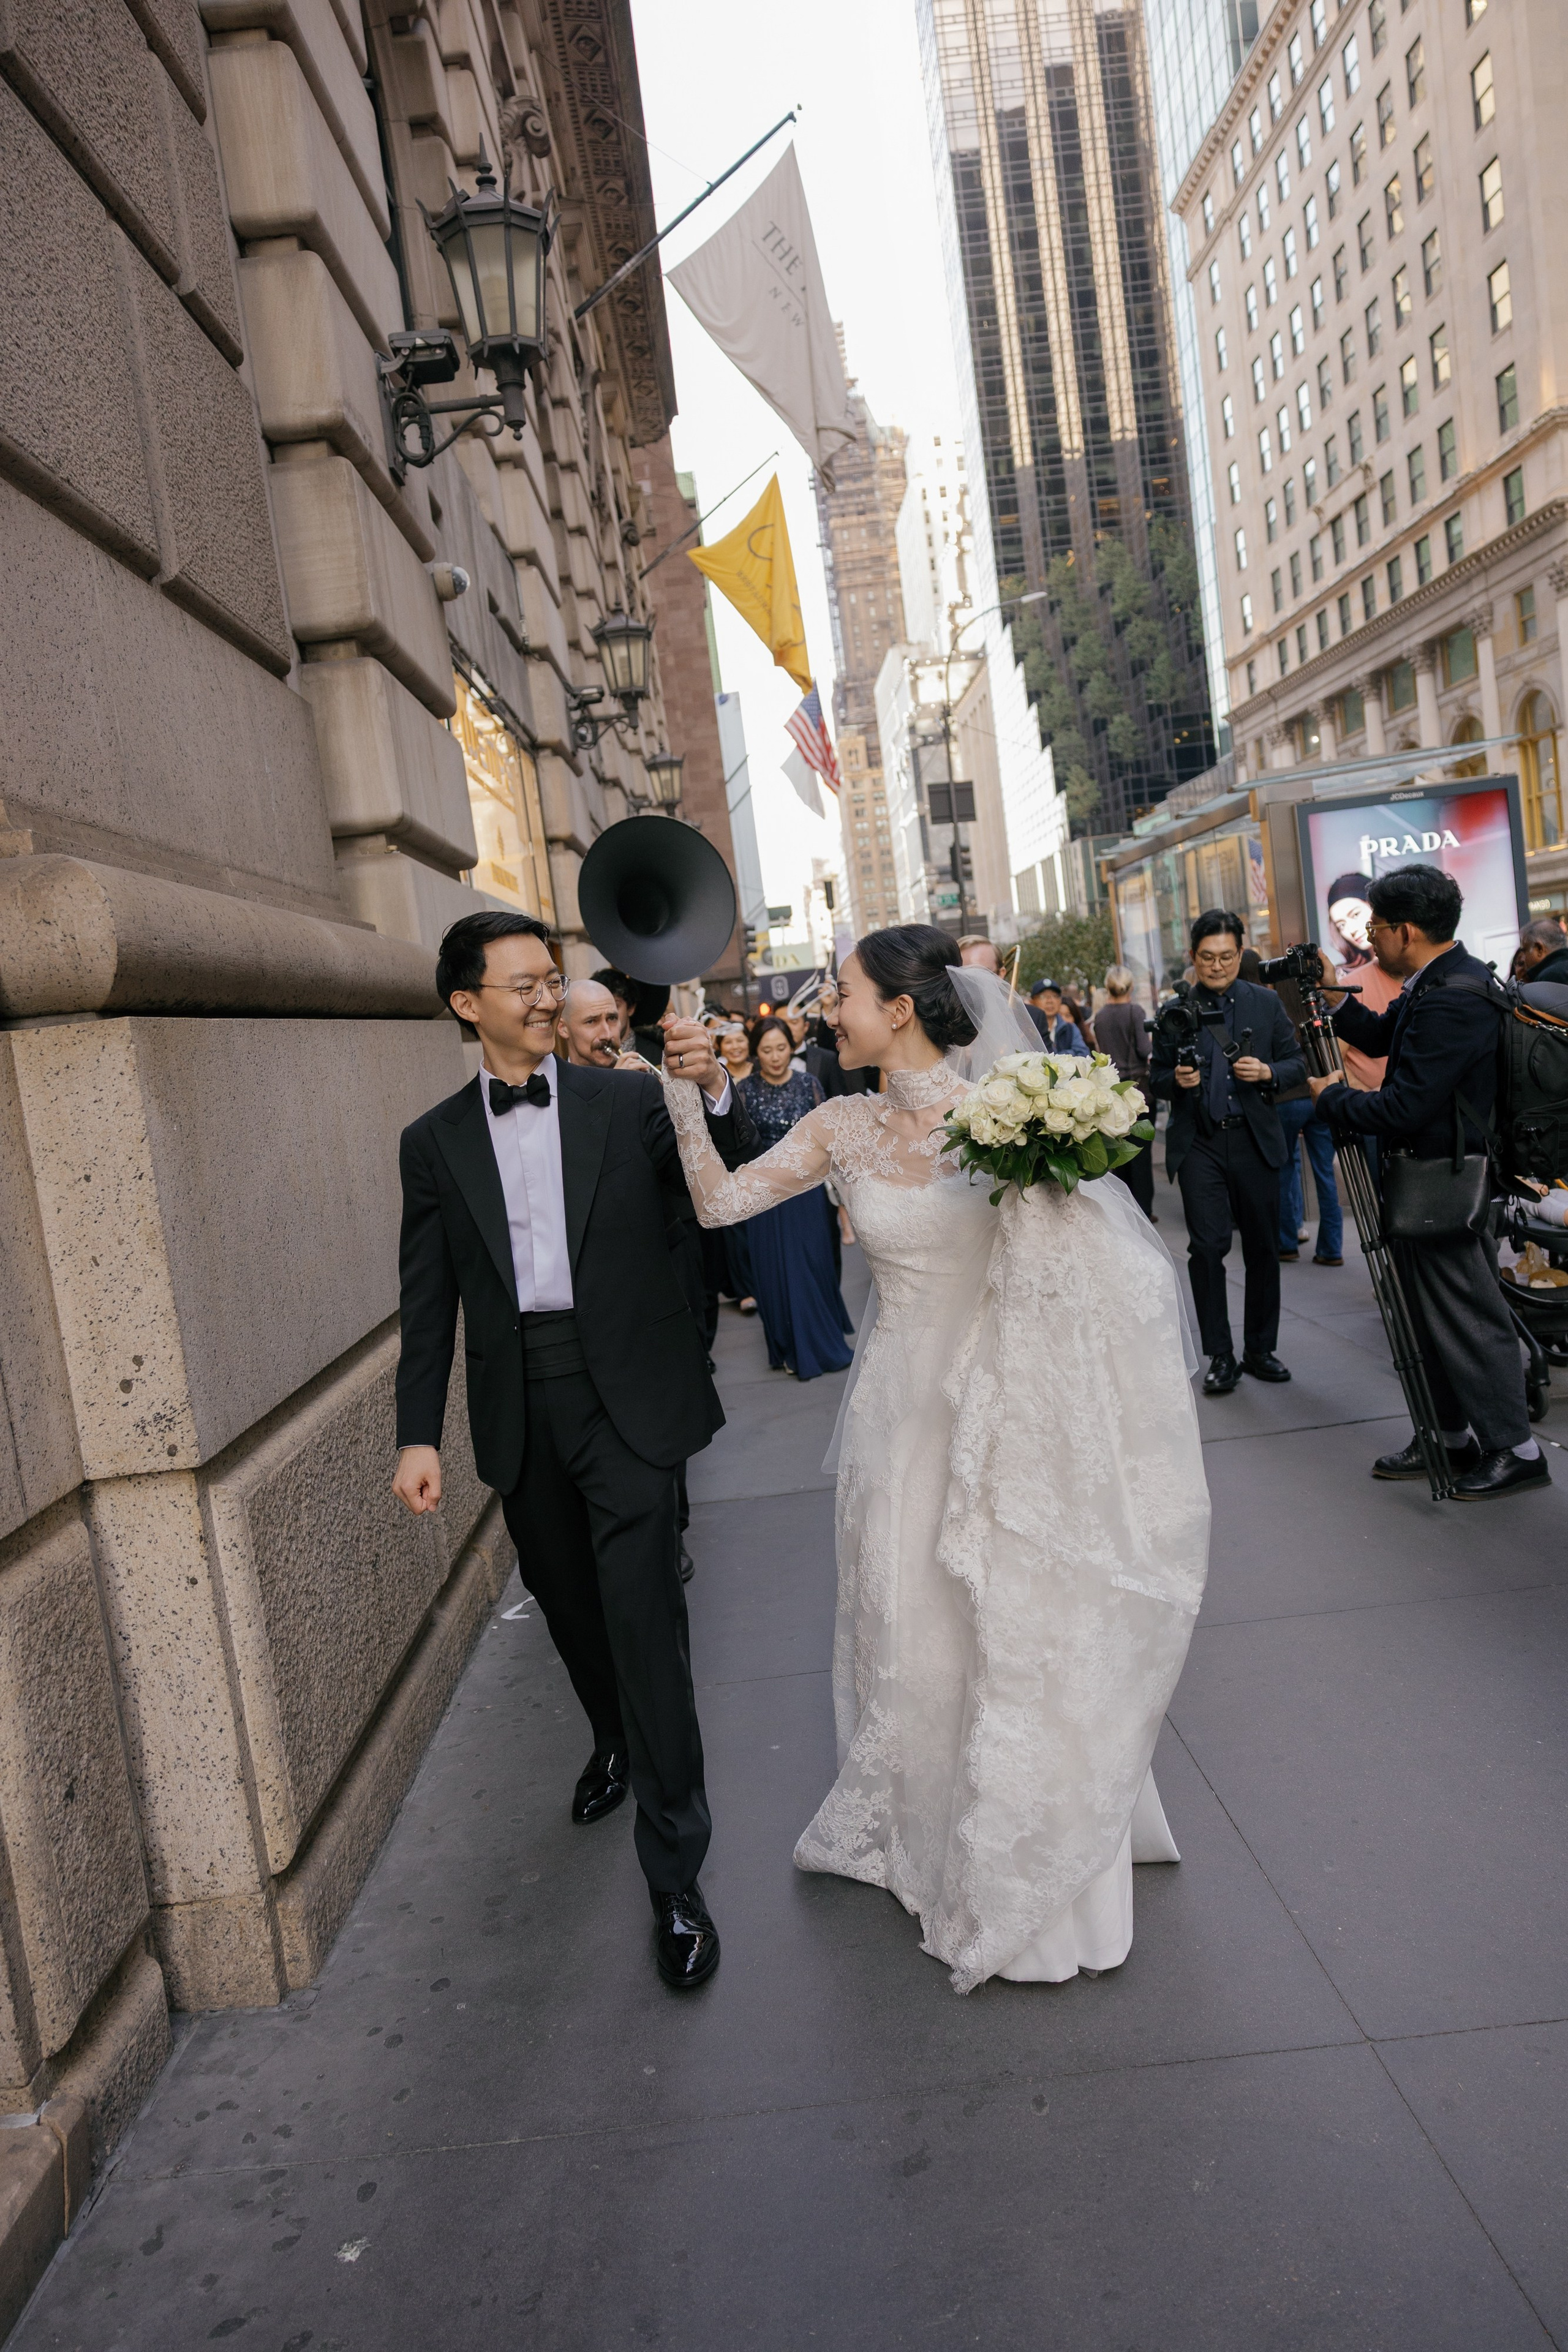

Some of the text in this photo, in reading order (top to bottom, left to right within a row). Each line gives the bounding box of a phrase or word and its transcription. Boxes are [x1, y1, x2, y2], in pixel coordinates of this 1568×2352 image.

[762, 221, 804, 276] THE
[769, 287, 804, 327] NEW
[1390, 791, 1425, 801] JCDecaux
[1360, 829, 1461, 859] PRADA
